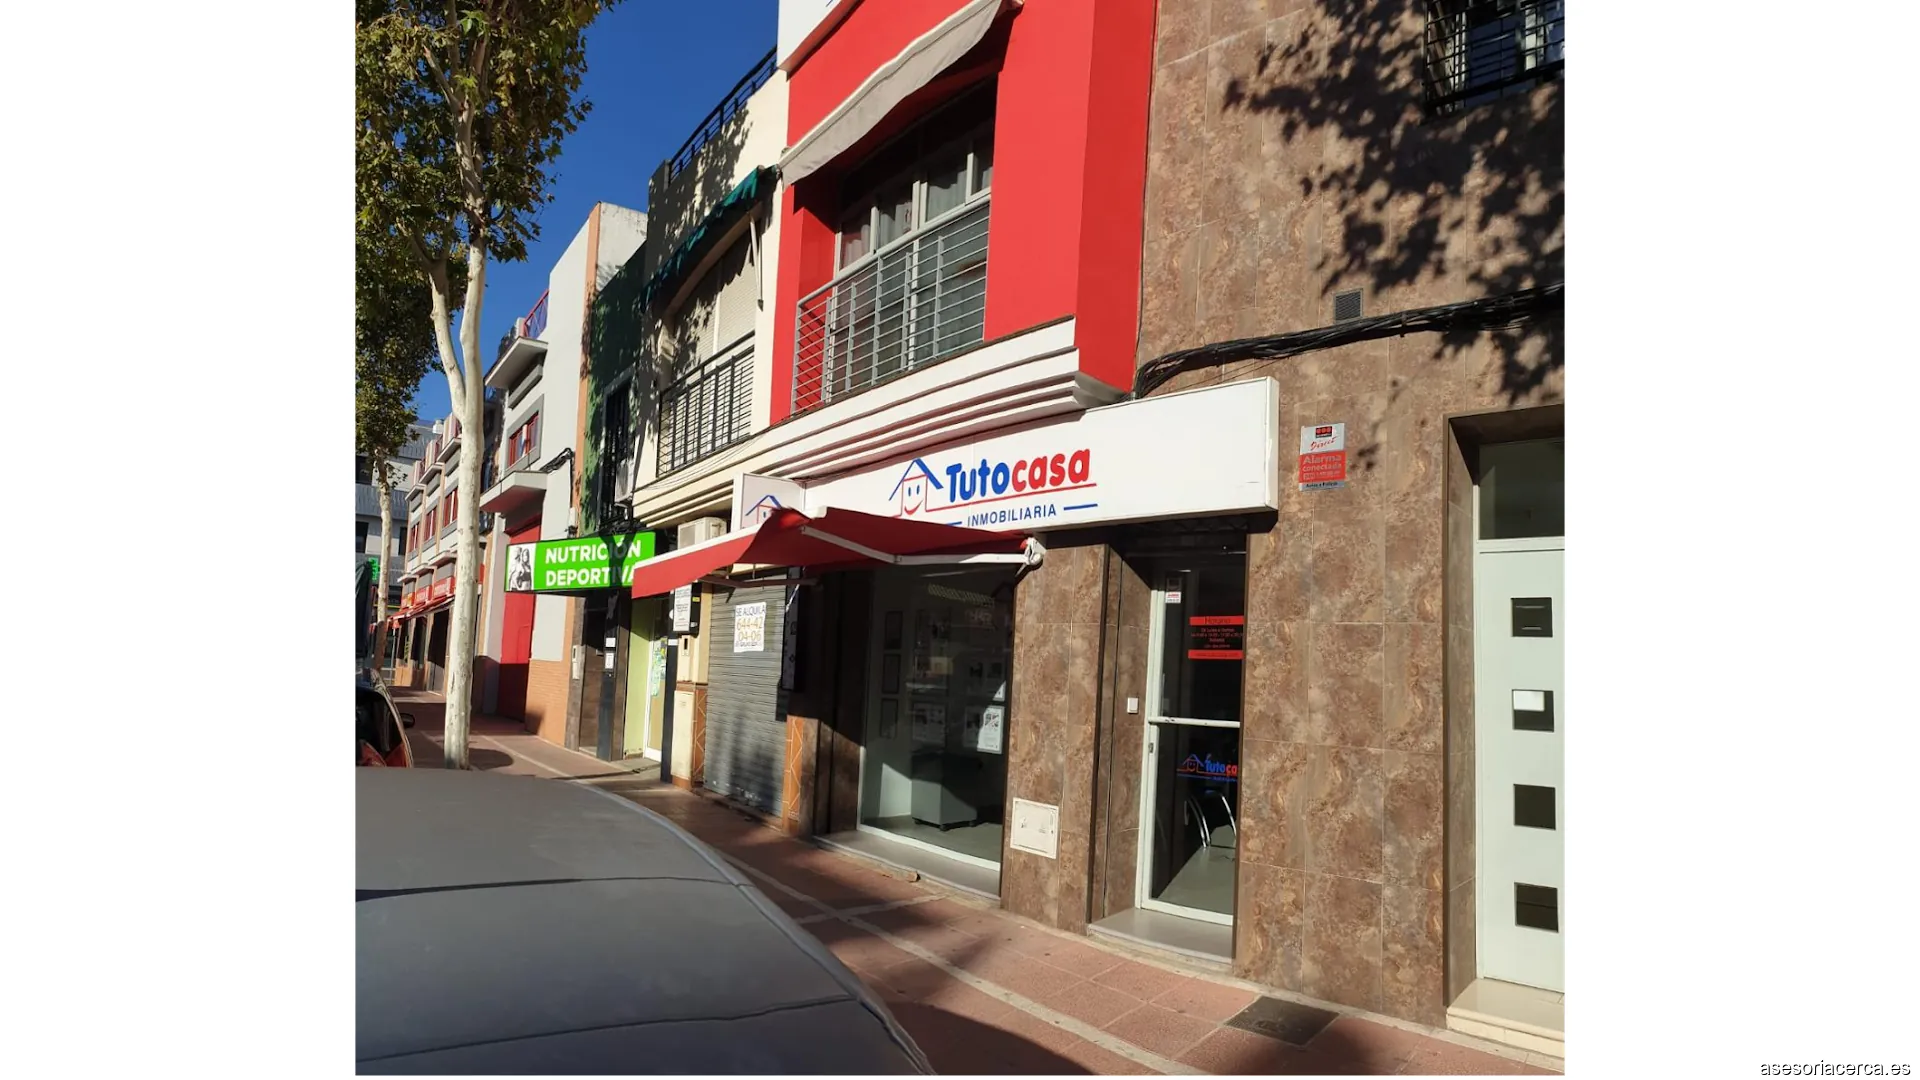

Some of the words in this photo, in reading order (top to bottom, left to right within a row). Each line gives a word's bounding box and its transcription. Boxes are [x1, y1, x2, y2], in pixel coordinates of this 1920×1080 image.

[1303, 454, 1342, 465] Alarma
[967, 504, 1057, 527] INMOBILIARIA
[545, 538, 642, 564] NUTRICIÓN
